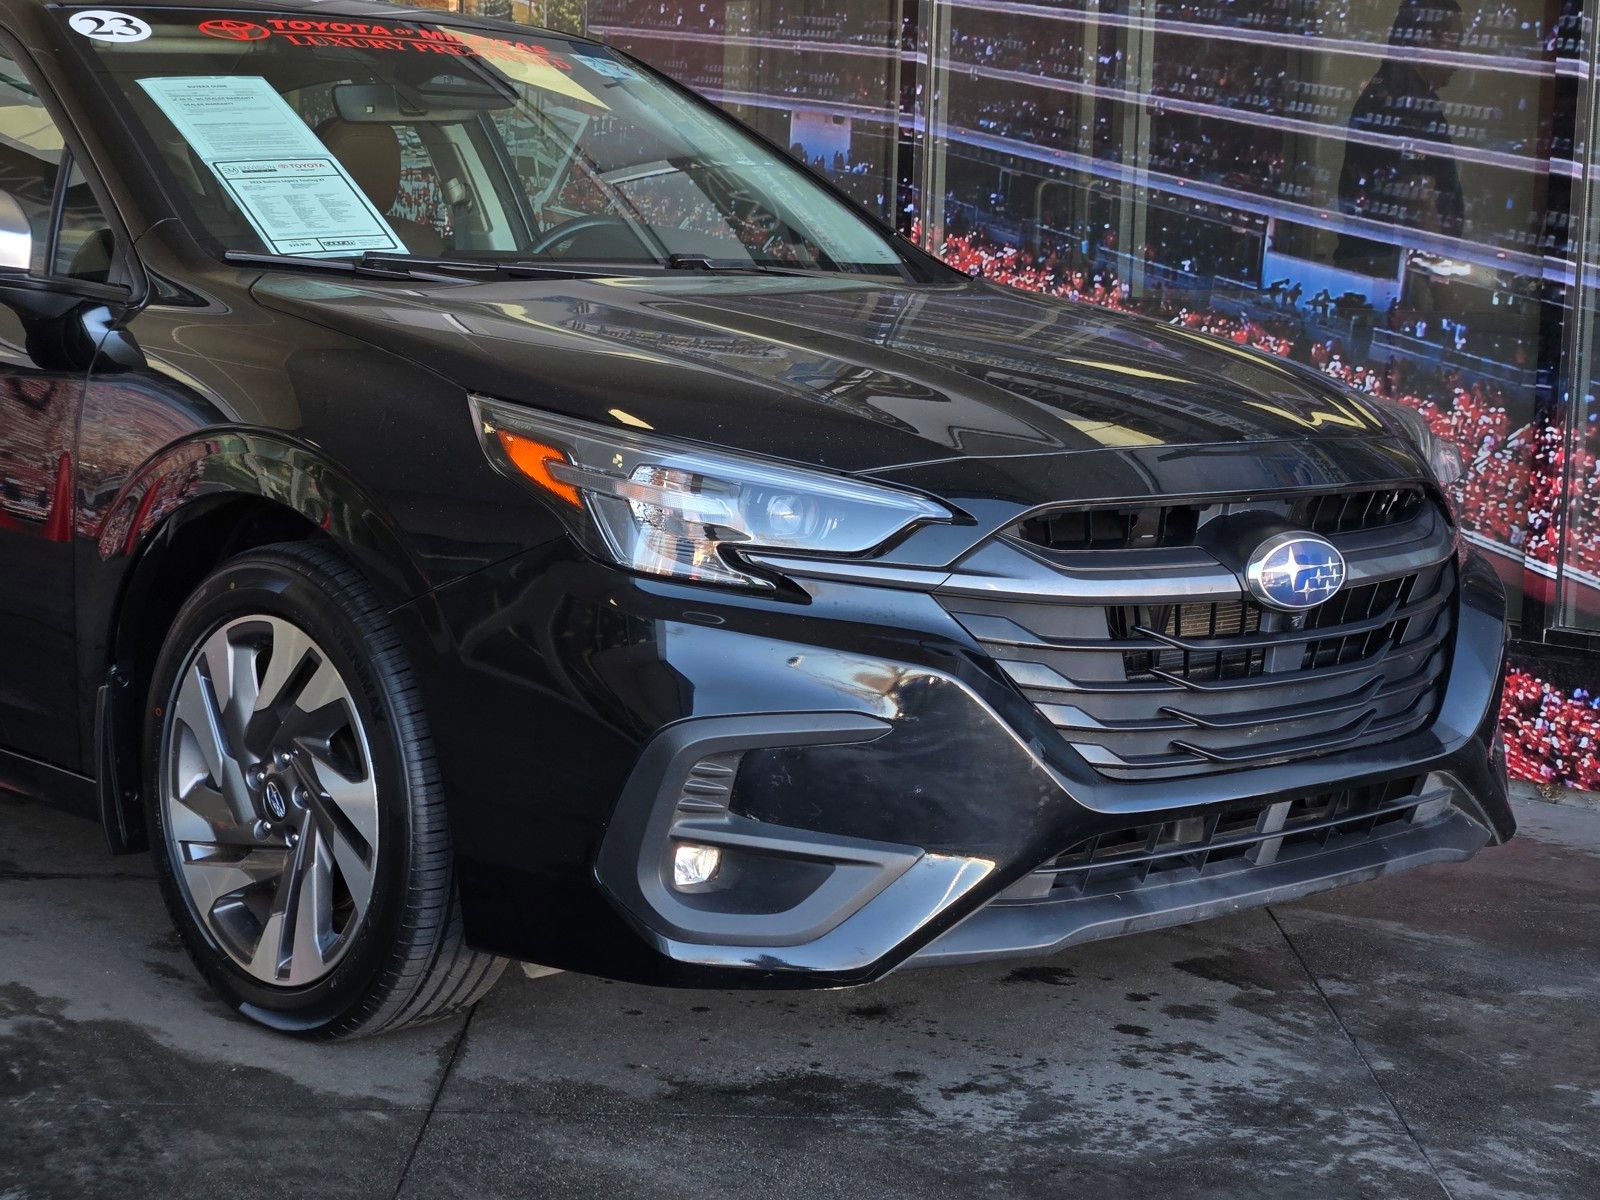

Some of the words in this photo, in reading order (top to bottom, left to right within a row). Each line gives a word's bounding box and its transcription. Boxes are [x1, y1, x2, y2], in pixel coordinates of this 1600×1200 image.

[79, 17, 142, 36] 23
[266, 19, 393, 36] TOYOTA
[282, 35, 407, 51] LUXURY
